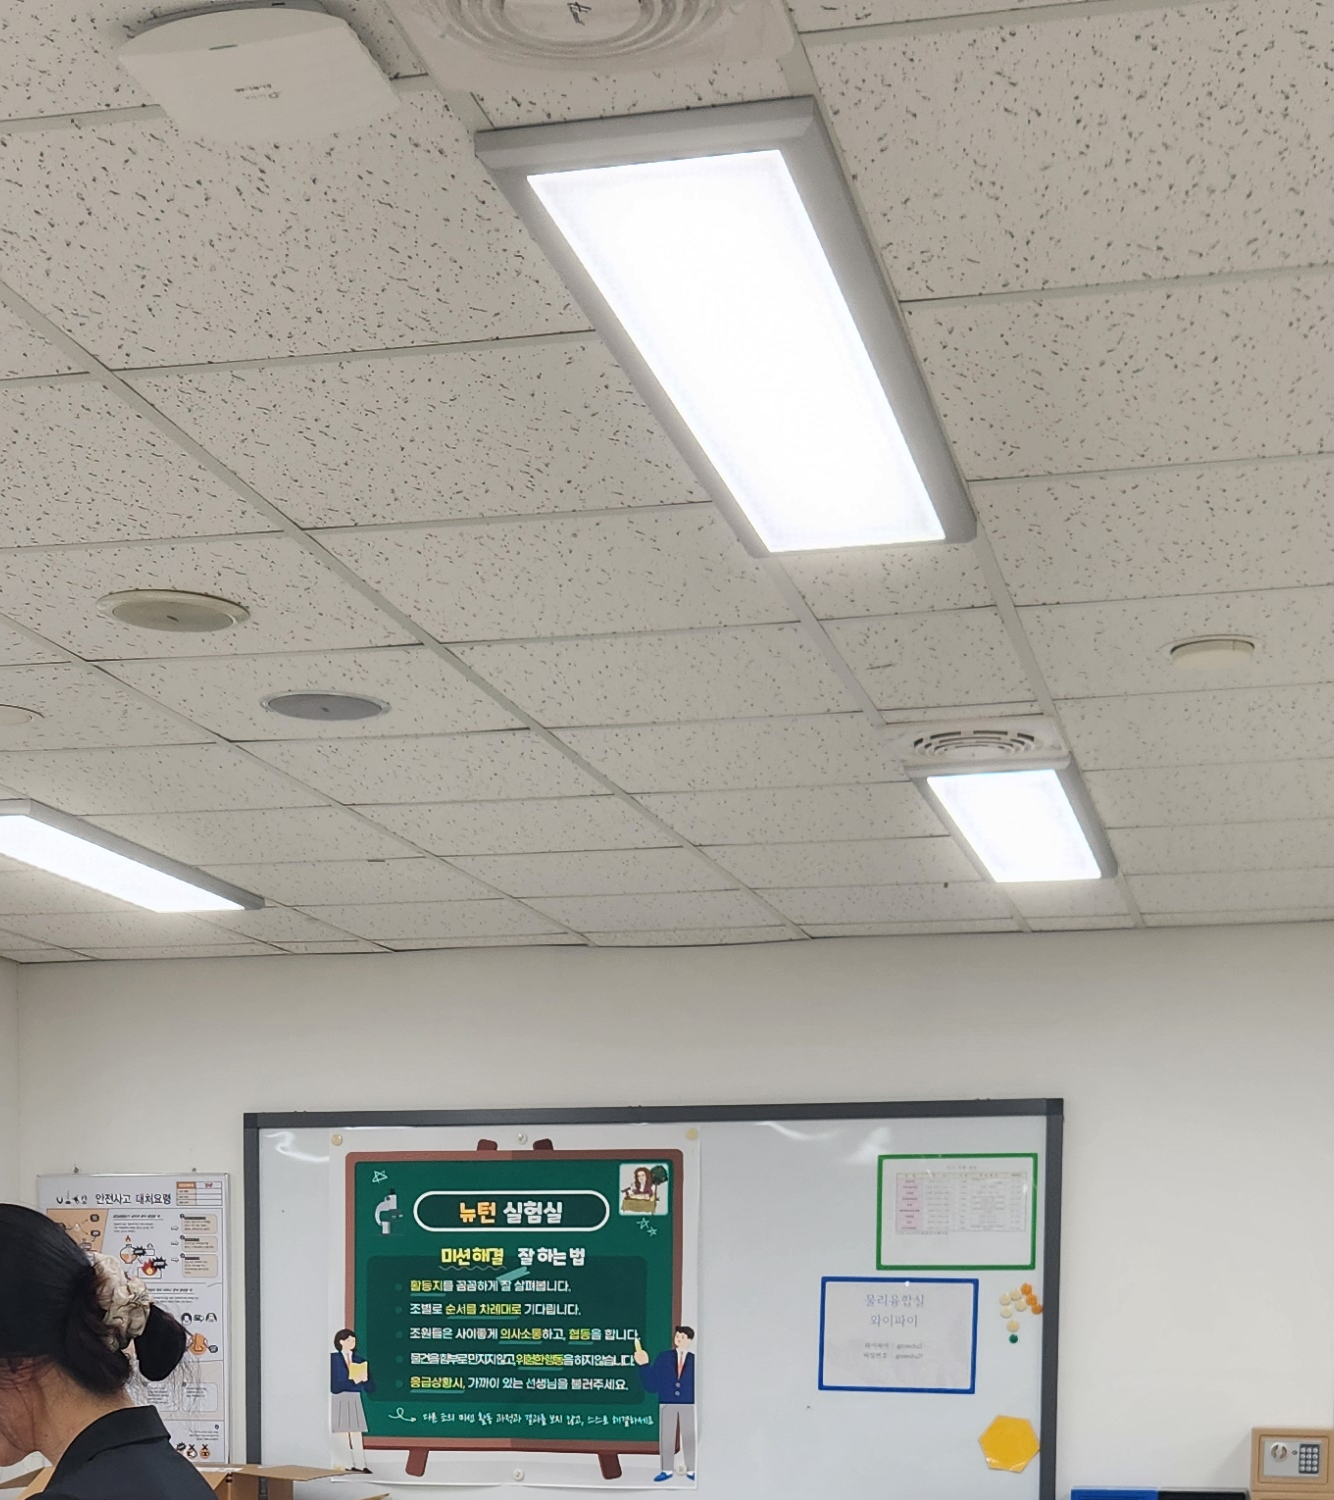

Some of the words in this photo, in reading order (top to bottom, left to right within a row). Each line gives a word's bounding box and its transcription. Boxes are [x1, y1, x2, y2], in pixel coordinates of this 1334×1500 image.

[95, 1193, 132, 1205] 안전사고
[135, 1193, 172, 1205] 대처요령
[459, 1202, 497, 1224] 뉴턴
[503, 1201, 563, 1225] 실험실
[569, 1247, 586, 1266] 법
[410, 1280, 454, 1292] 활동지를
[456, 1280, 499, 1292] 꼼꼼하게
[501, 1280, 512, 1292] 잘
[409, 1303, 443, 1315] 조별로
[445, 1303, 477, 1315] 순서를
[479, 1303, 522, 1315] 차례대로
[524, 1303, 582, 1315] 기다립니다.
[870, 1314, 918, 1328] 와이파이
[409, 1327, 453, 1339] 조원들은
[468, 1377, 500, 1389] 가까이
[502, 1377, 524, 1390] 있는
[526, 1377, 568, 1390] 선생님을
